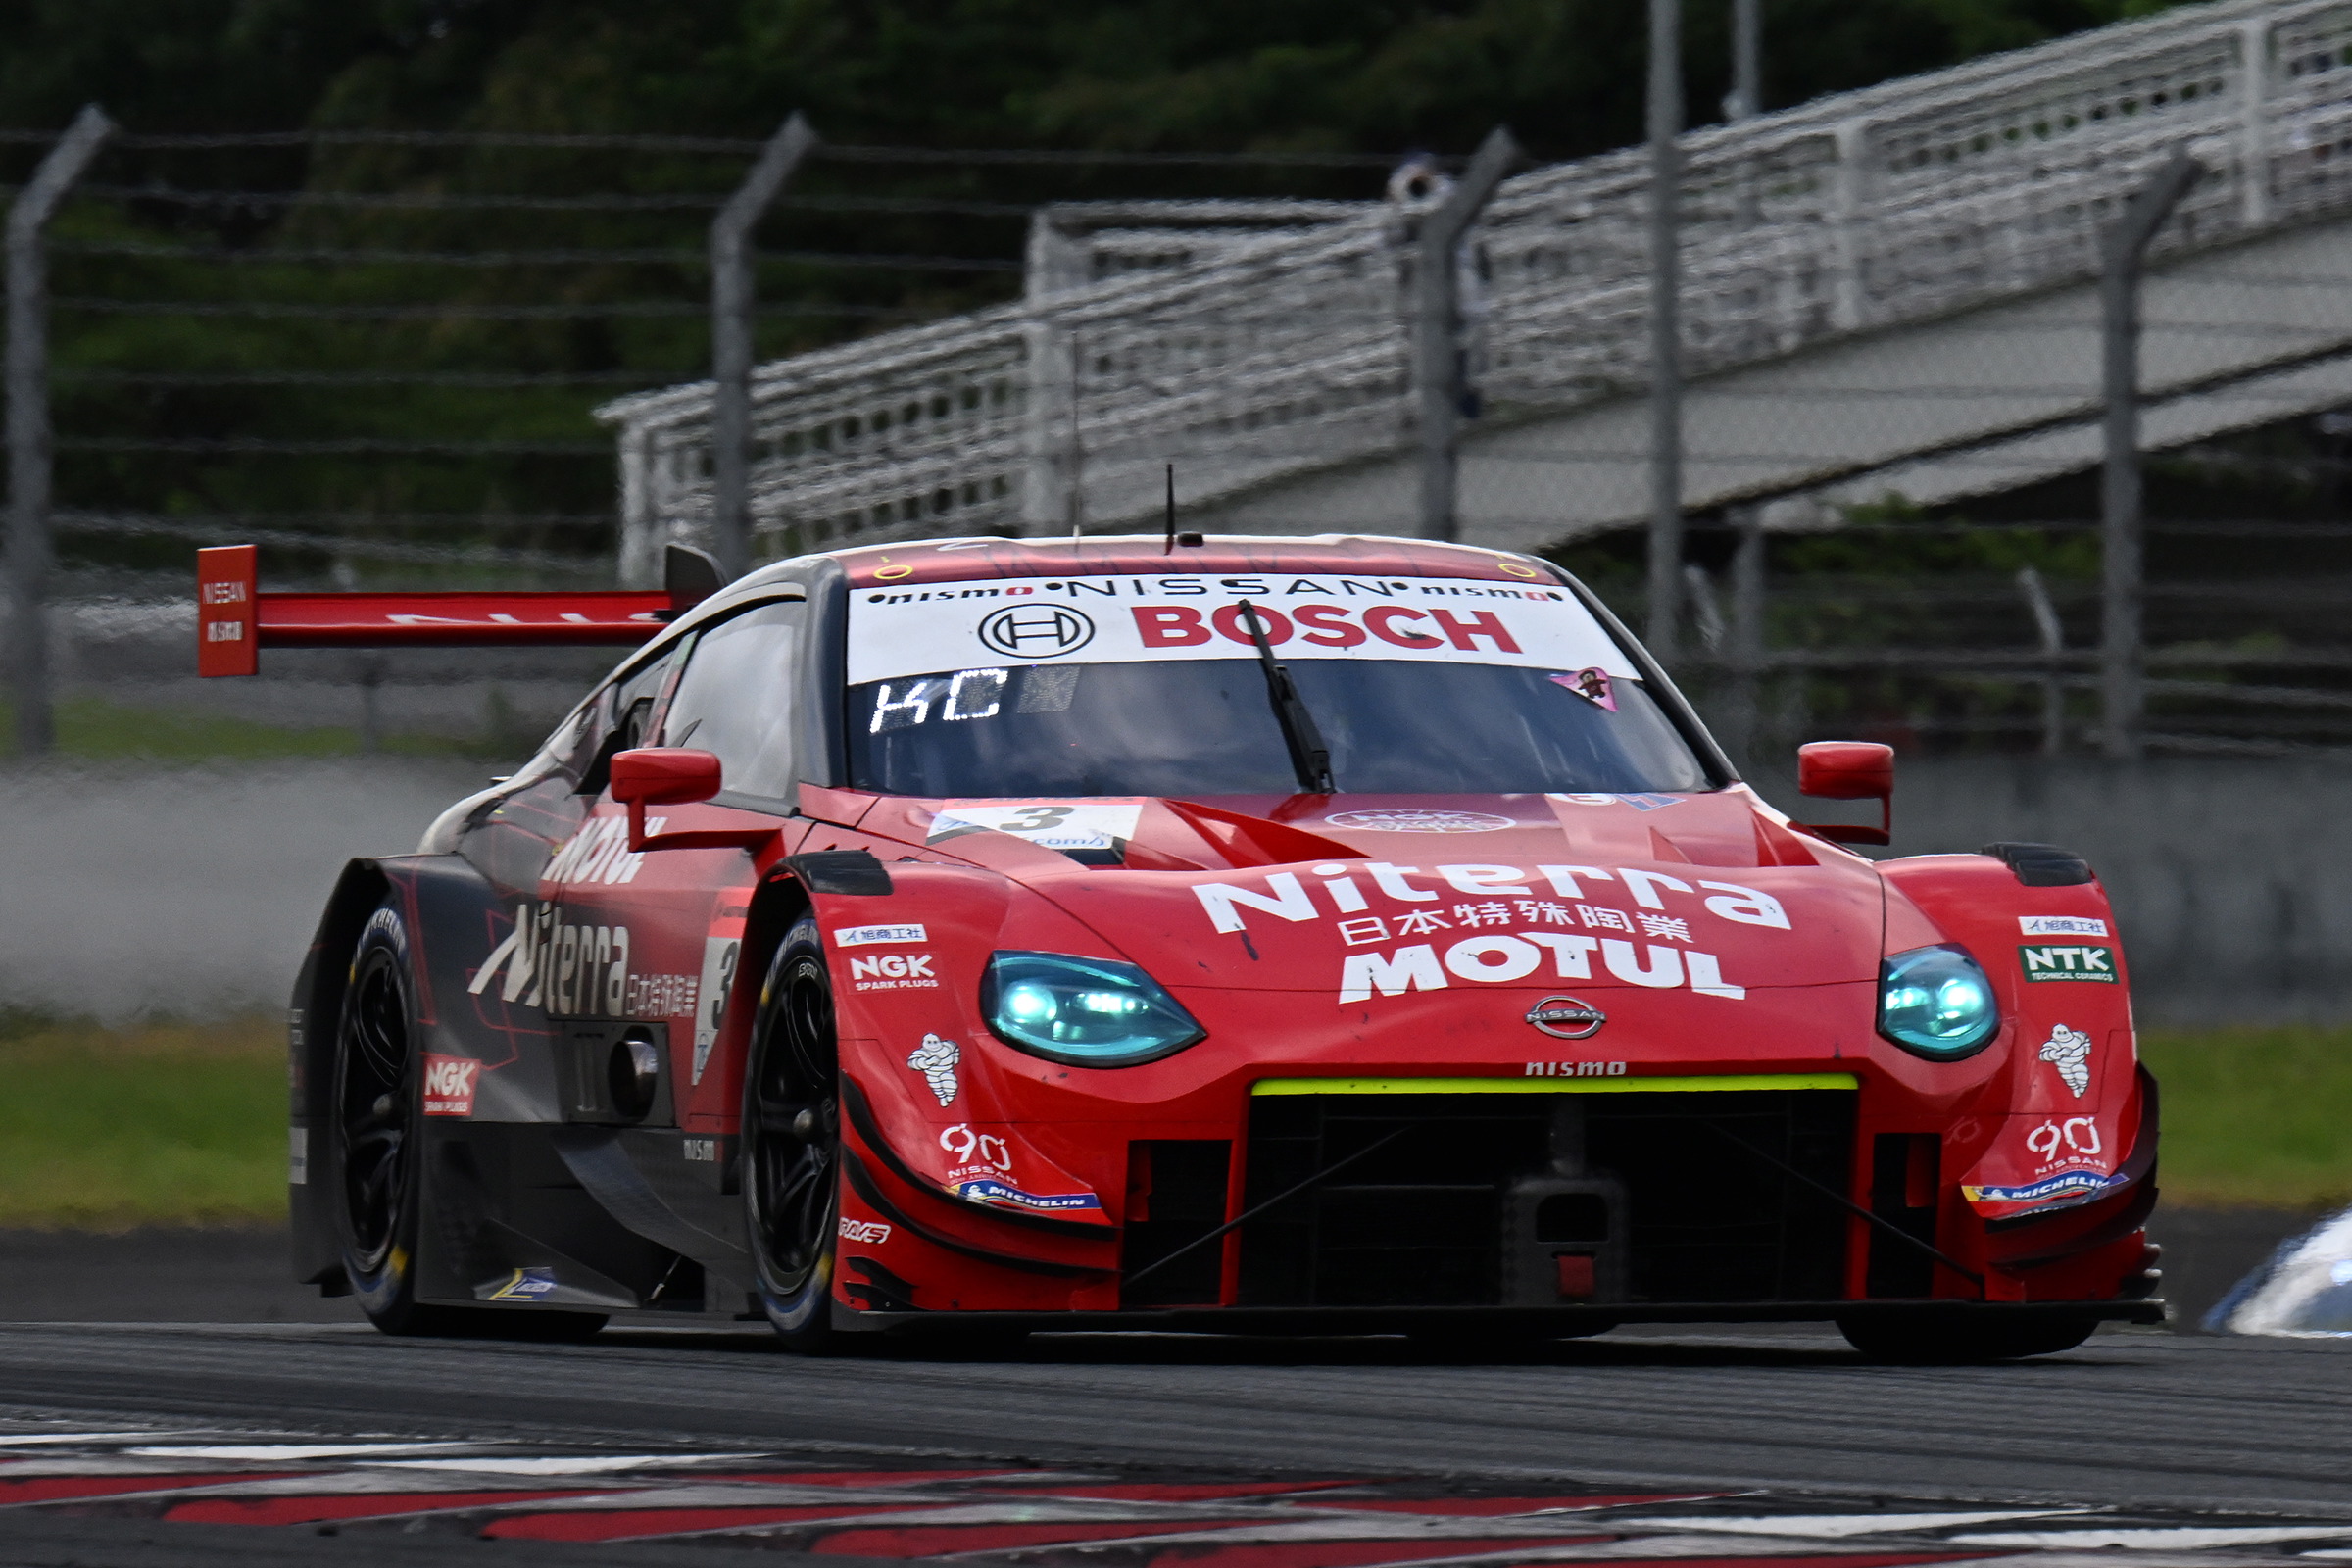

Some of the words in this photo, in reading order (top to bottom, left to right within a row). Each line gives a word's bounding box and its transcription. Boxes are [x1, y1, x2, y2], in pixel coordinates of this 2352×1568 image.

[1067, 577, 1394, 598] NISSAN
[1131, 603, 1523, 654] BOSCH
[999, 806, 1074, 831] 3
[1192, 862, 1791, 933] Niterra
[1337, 899, 1693, 948] 日本特殊陶業
[467, 901, 630, 1017] Niterra
[850, 954, 935, 980] NGK
[1339, 932, 1745, 1004] MOTUL
[2025, 947, 2109, 971] NTK
[712, 941, 737, 1030] 3
[856, 980, 897, 991] SPARK
[899, 979, 939, 988] PLUGS
[1526, 1009, 1605, 1020] NISSAN
[424, 1062, 475, 1096] NGK
[939, 1123, 1011, 1171] 90
[2027, 1117, 2101, 1162] 90
[947, 1165, 1018, 1186] NISSAN
[2034, 1155, 2107, 1175] NISSAN
[988, 1186, 1085, 1207] MICHELIN
